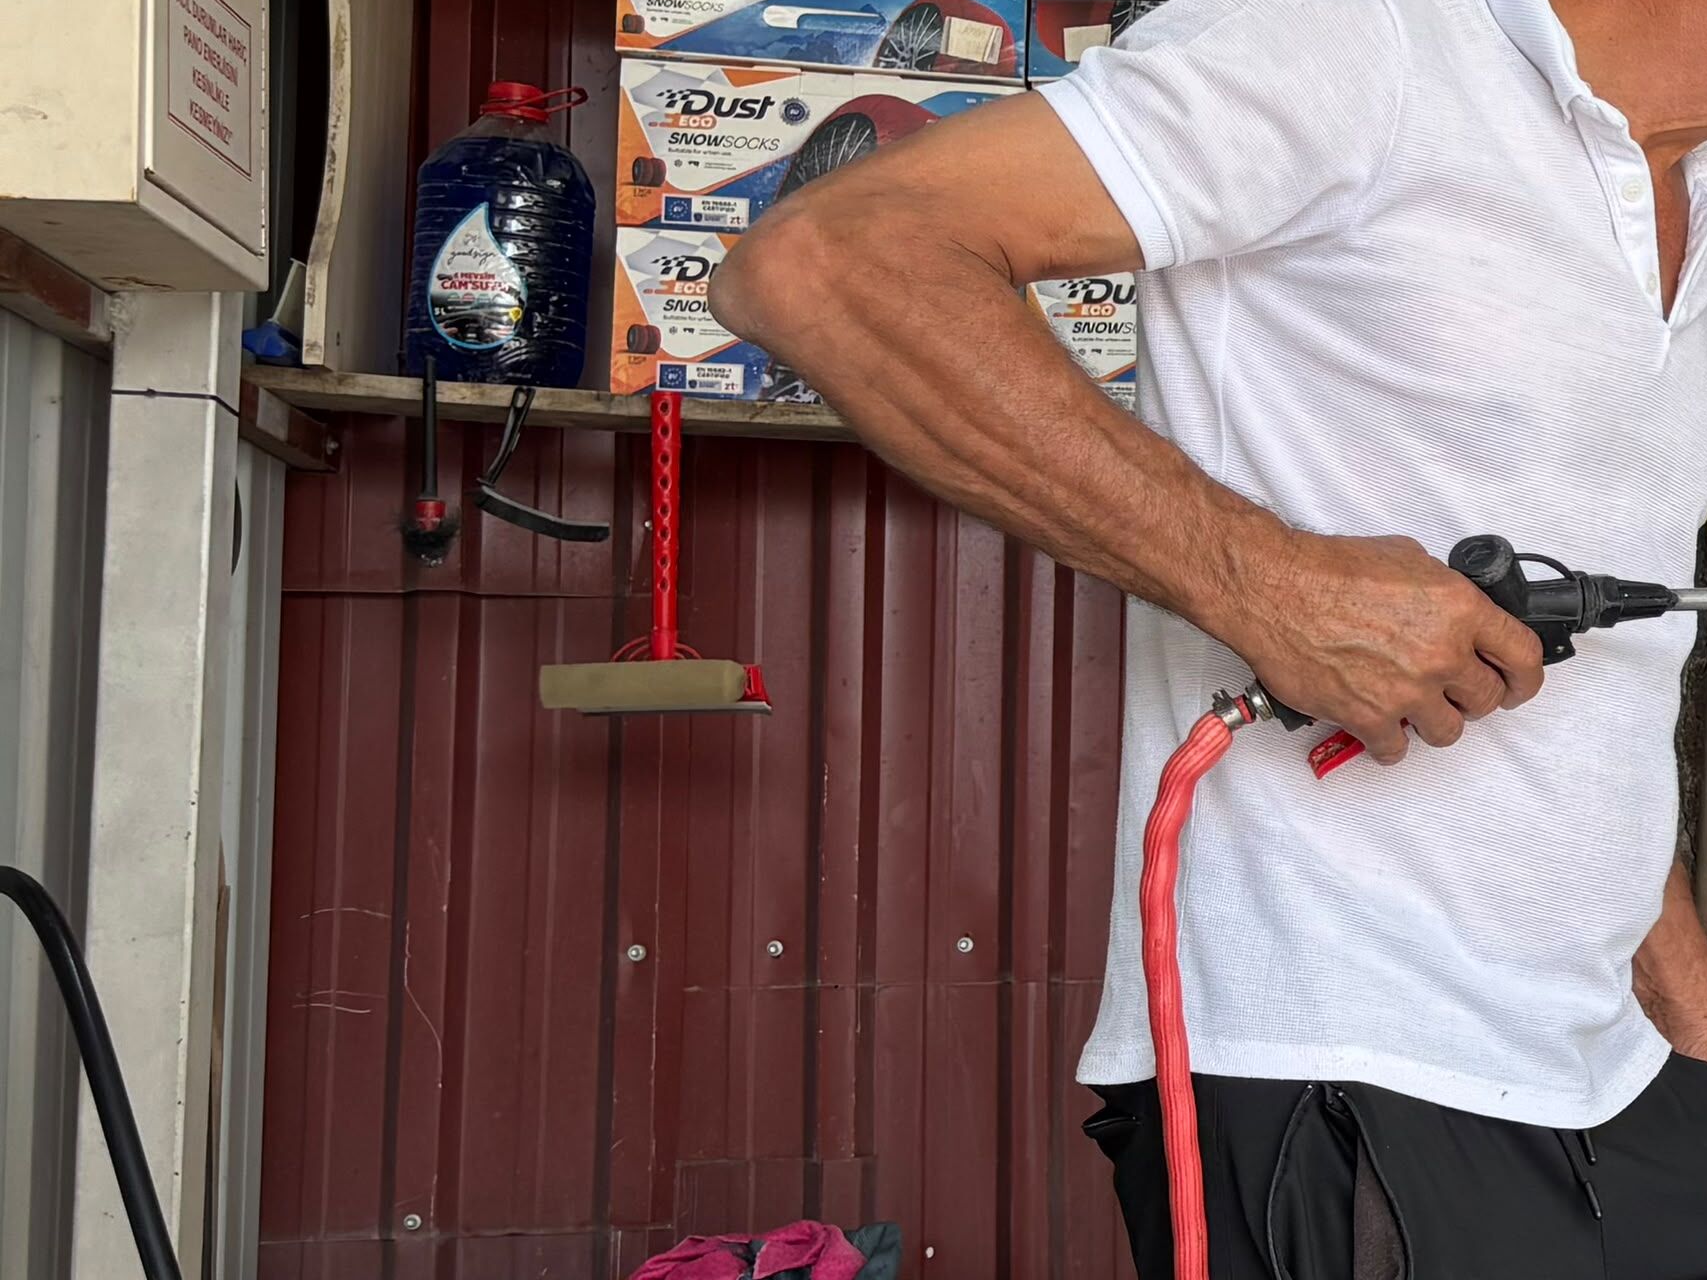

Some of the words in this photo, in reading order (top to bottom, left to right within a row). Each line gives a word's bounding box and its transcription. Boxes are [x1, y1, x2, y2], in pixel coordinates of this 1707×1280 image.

[668, 88, 775, 119] Dust
[678, 115, 714, 127] ECO
[668, 132, 780, 151] SNOWSOCKS
